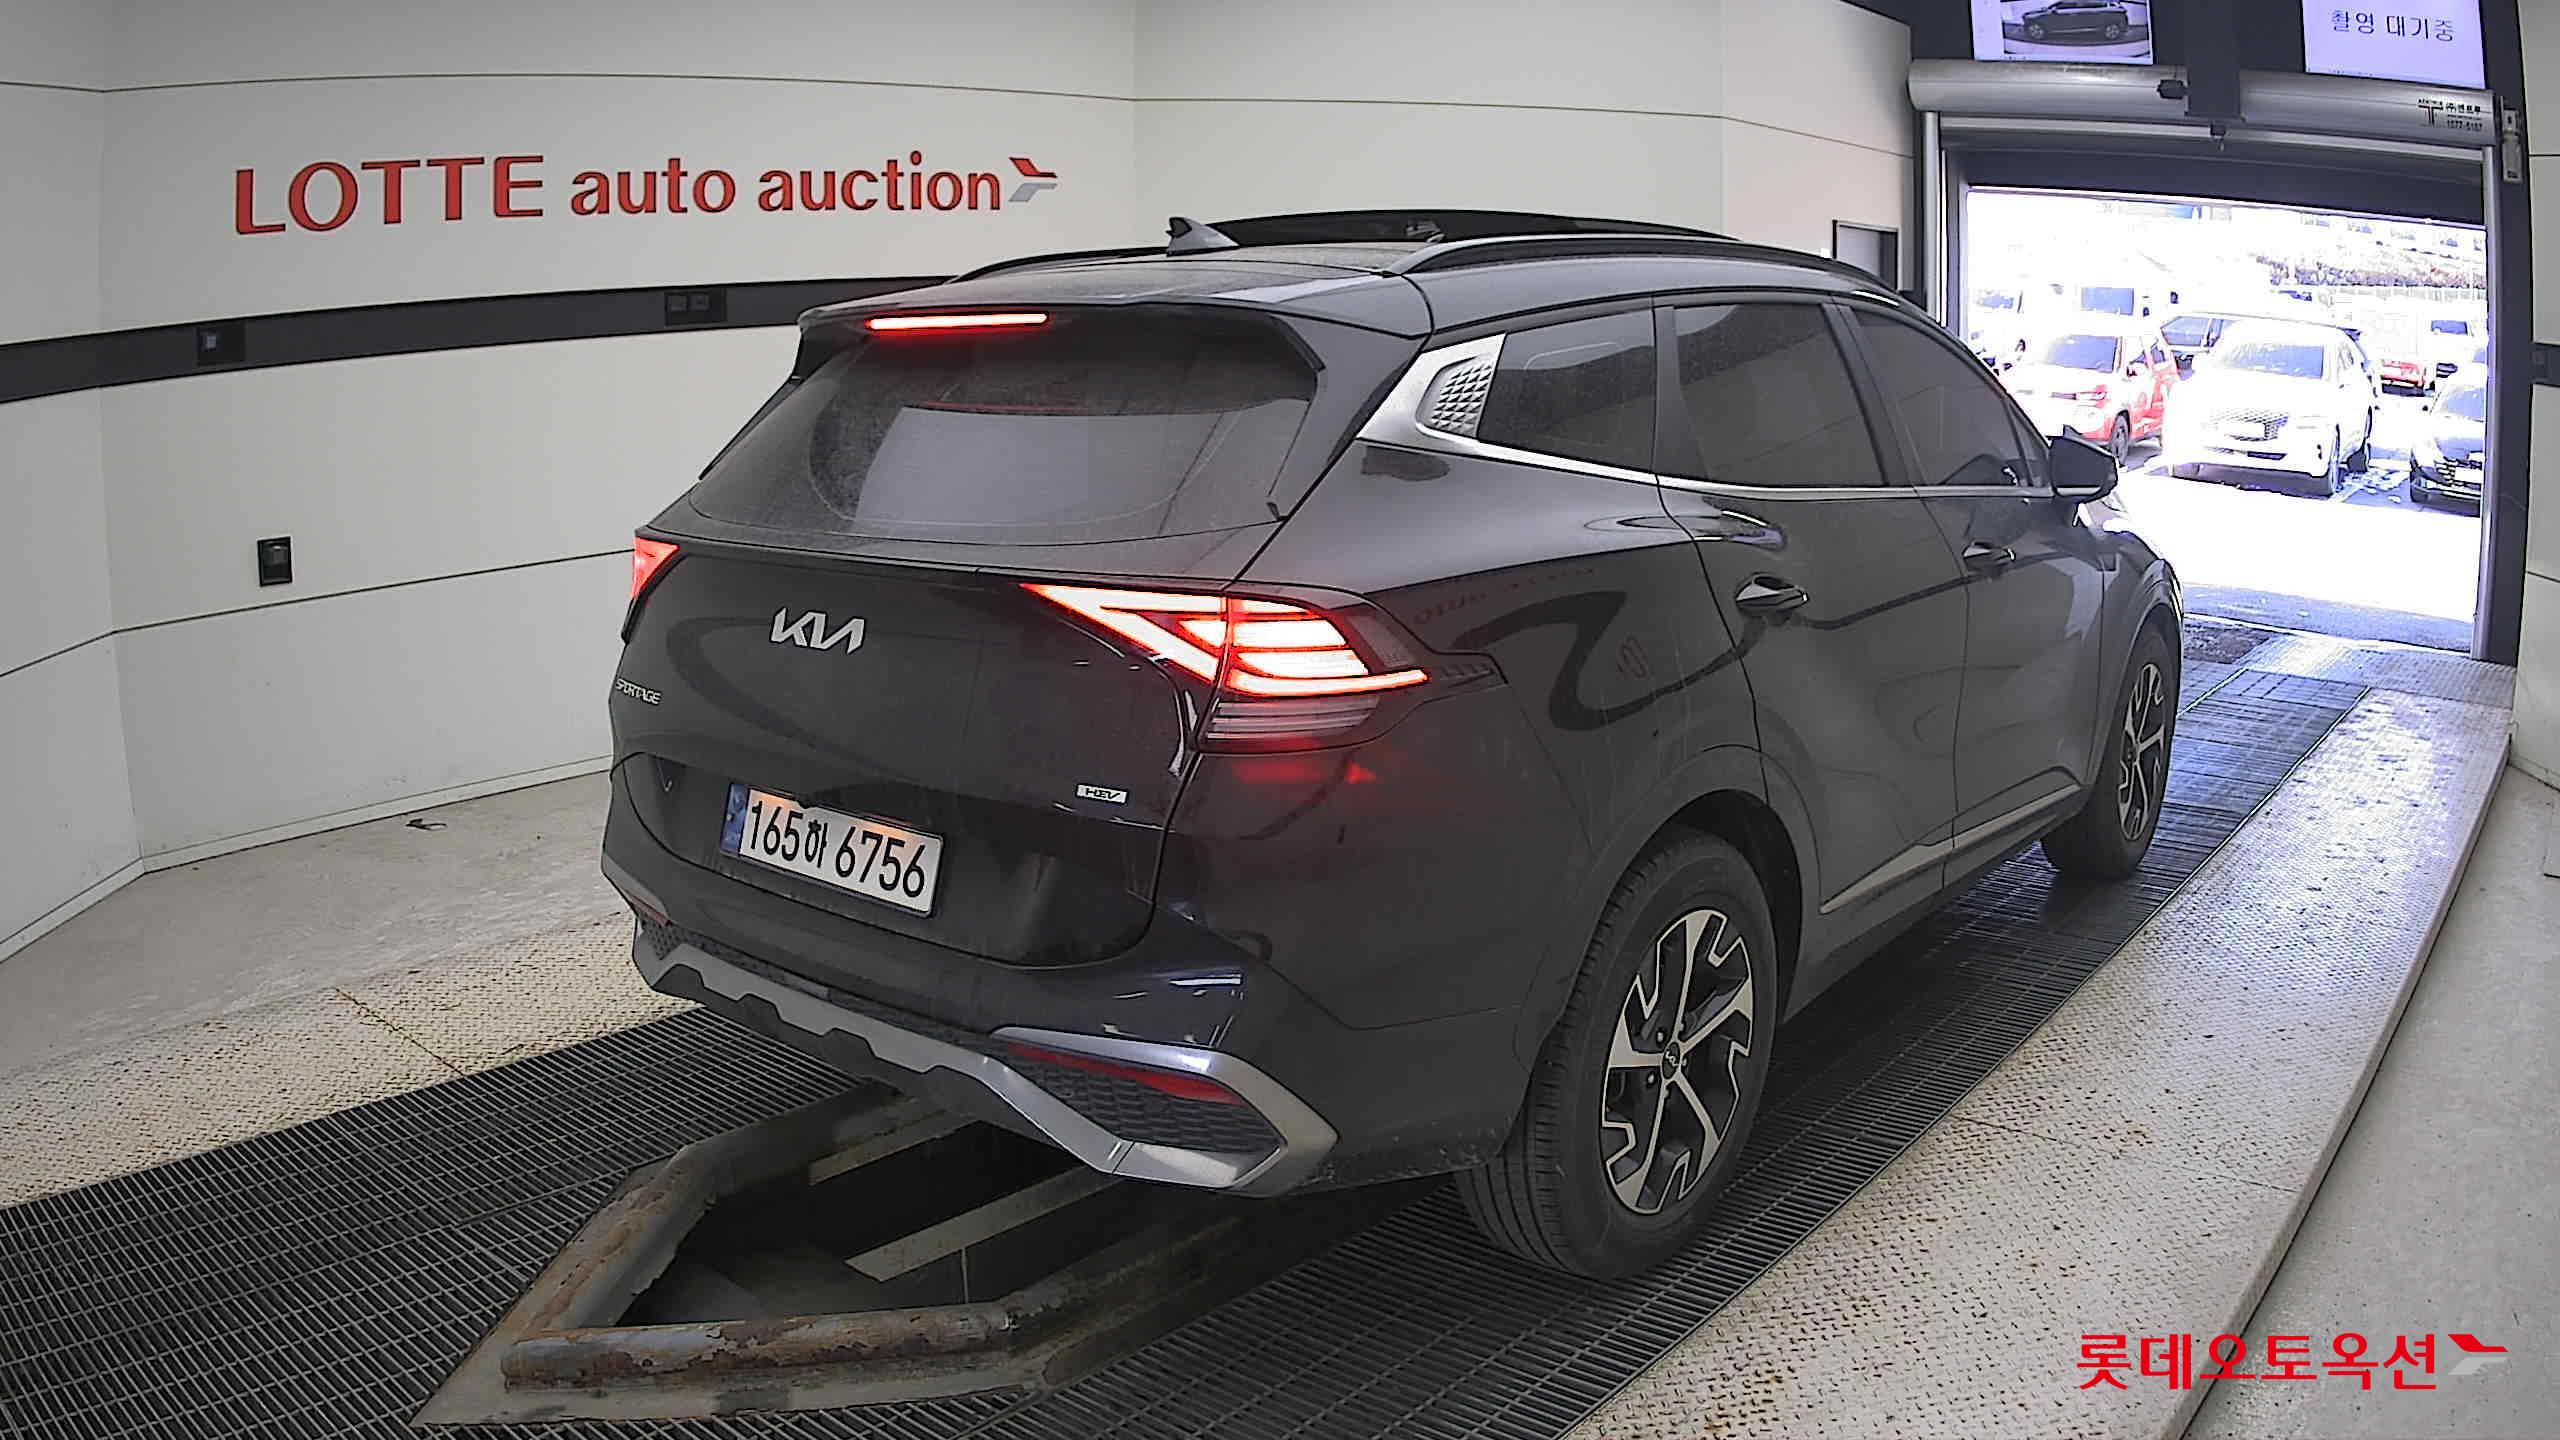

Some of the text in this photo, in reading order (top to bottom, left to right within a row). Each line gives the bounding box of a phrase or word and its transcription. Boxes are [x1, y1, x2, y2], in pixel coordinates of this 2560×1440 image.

[2331, 9, 2454, 43] 촬영 대기중
[234, 150, 1002, 235] LOTTE auto auction
[768, 607, 866, 655] KIA
[615, 678, 661, 705] SPORTAGE
[1083, 786, 1122, 801] HEV
[834, 826, 926, 898] 6756
